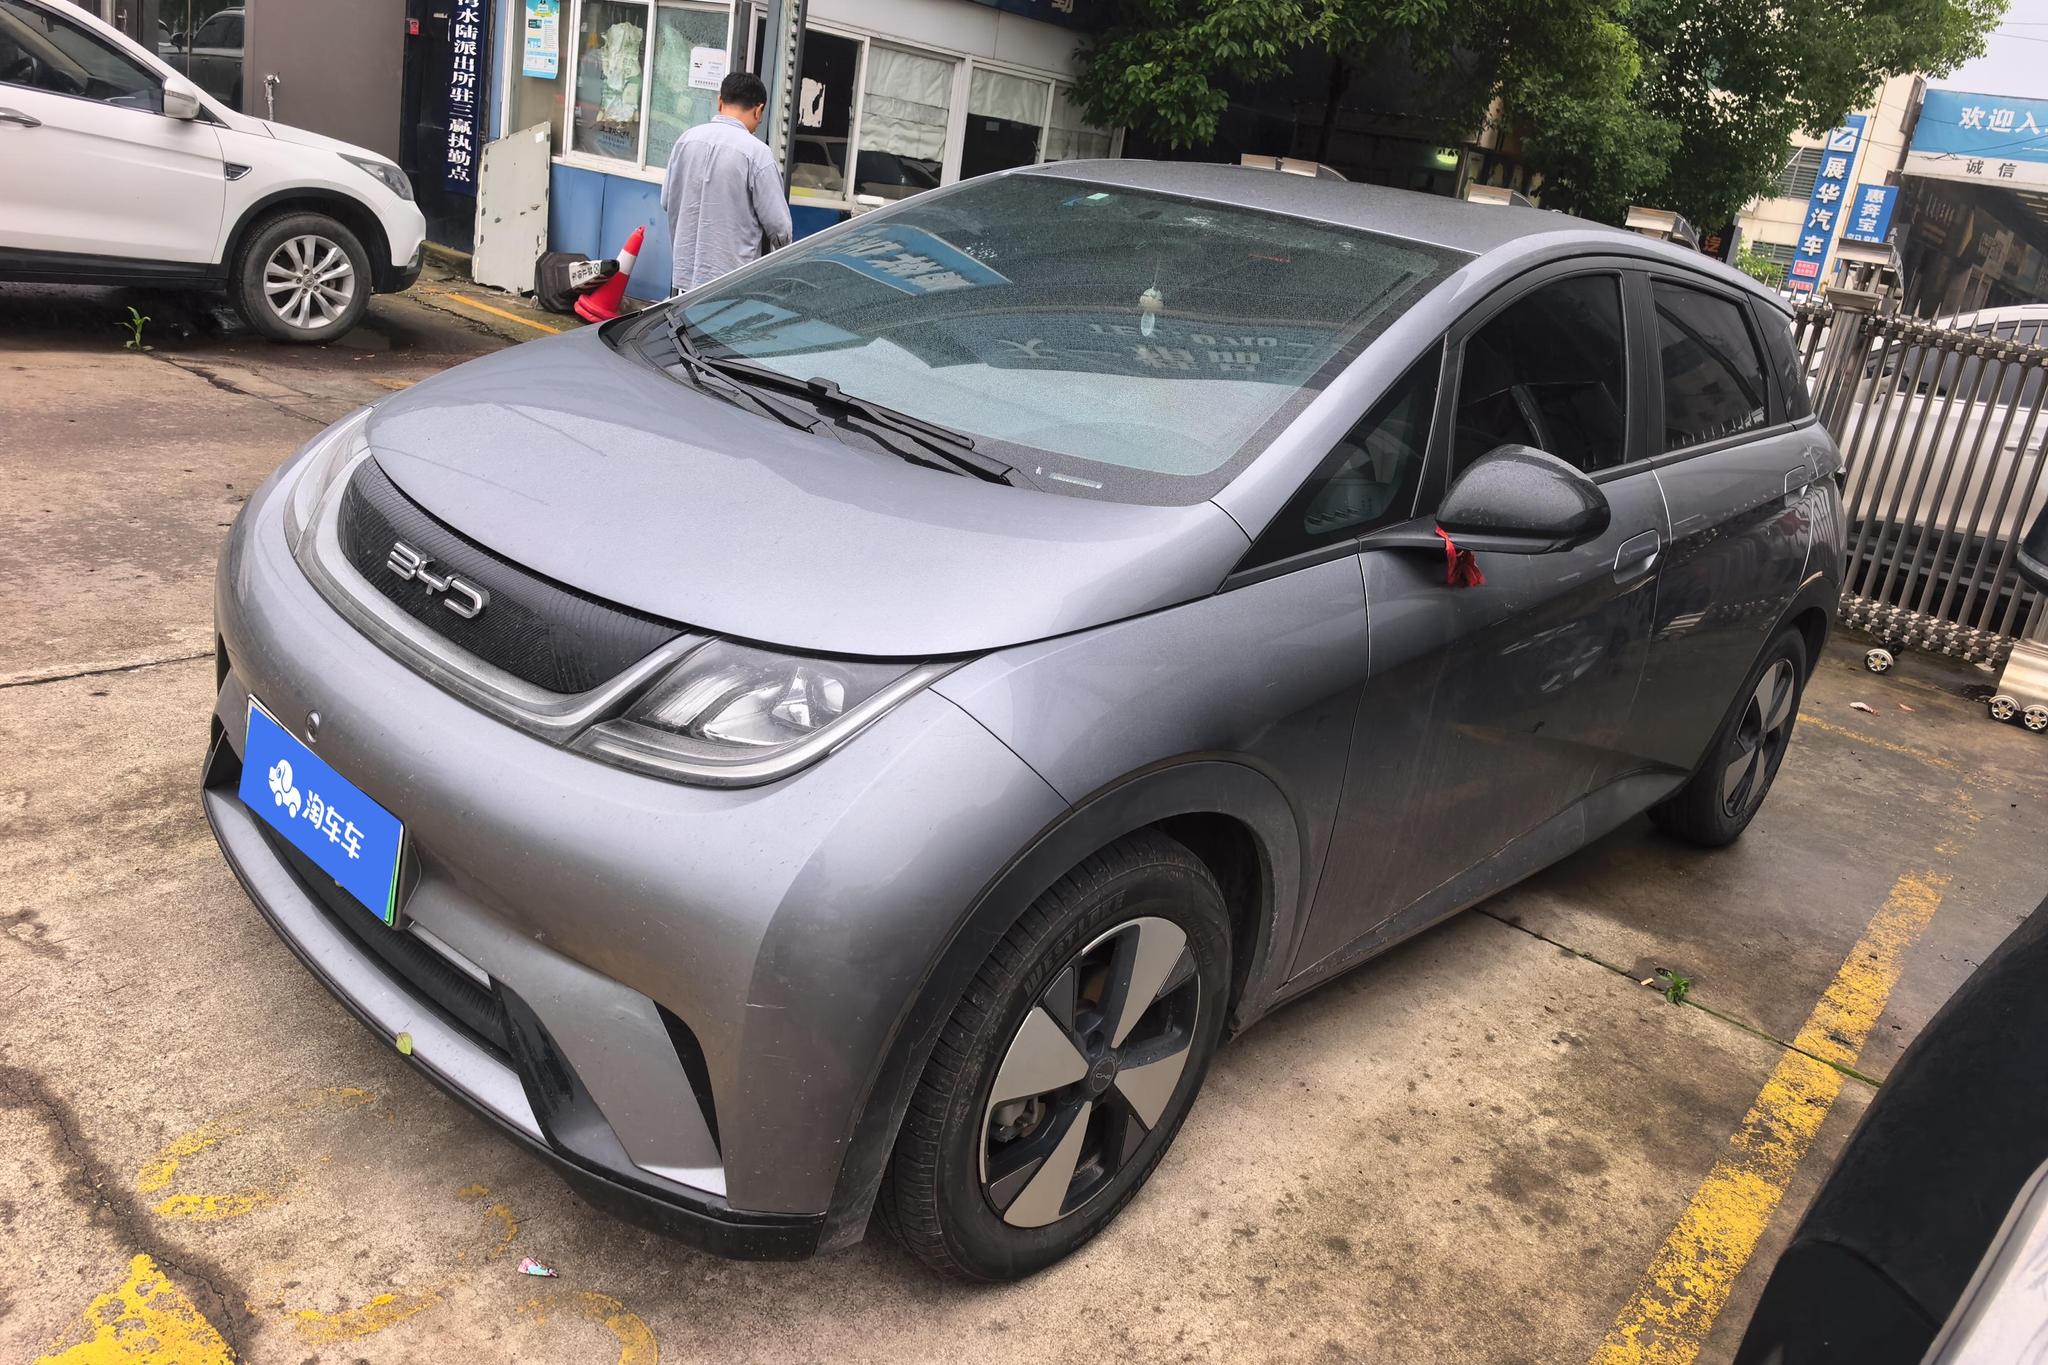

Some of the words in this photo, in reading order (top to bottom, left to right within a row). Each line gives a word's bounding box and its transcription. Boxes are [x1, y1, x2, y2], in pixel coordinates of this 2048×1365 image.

[1958, 106, 2048, 135] 欢迎入
[1966, 160, 2017, 178] 诚信
[1801, 157, 1847, 257] 展华汽车
[387, 542, 486, 618] BYD
